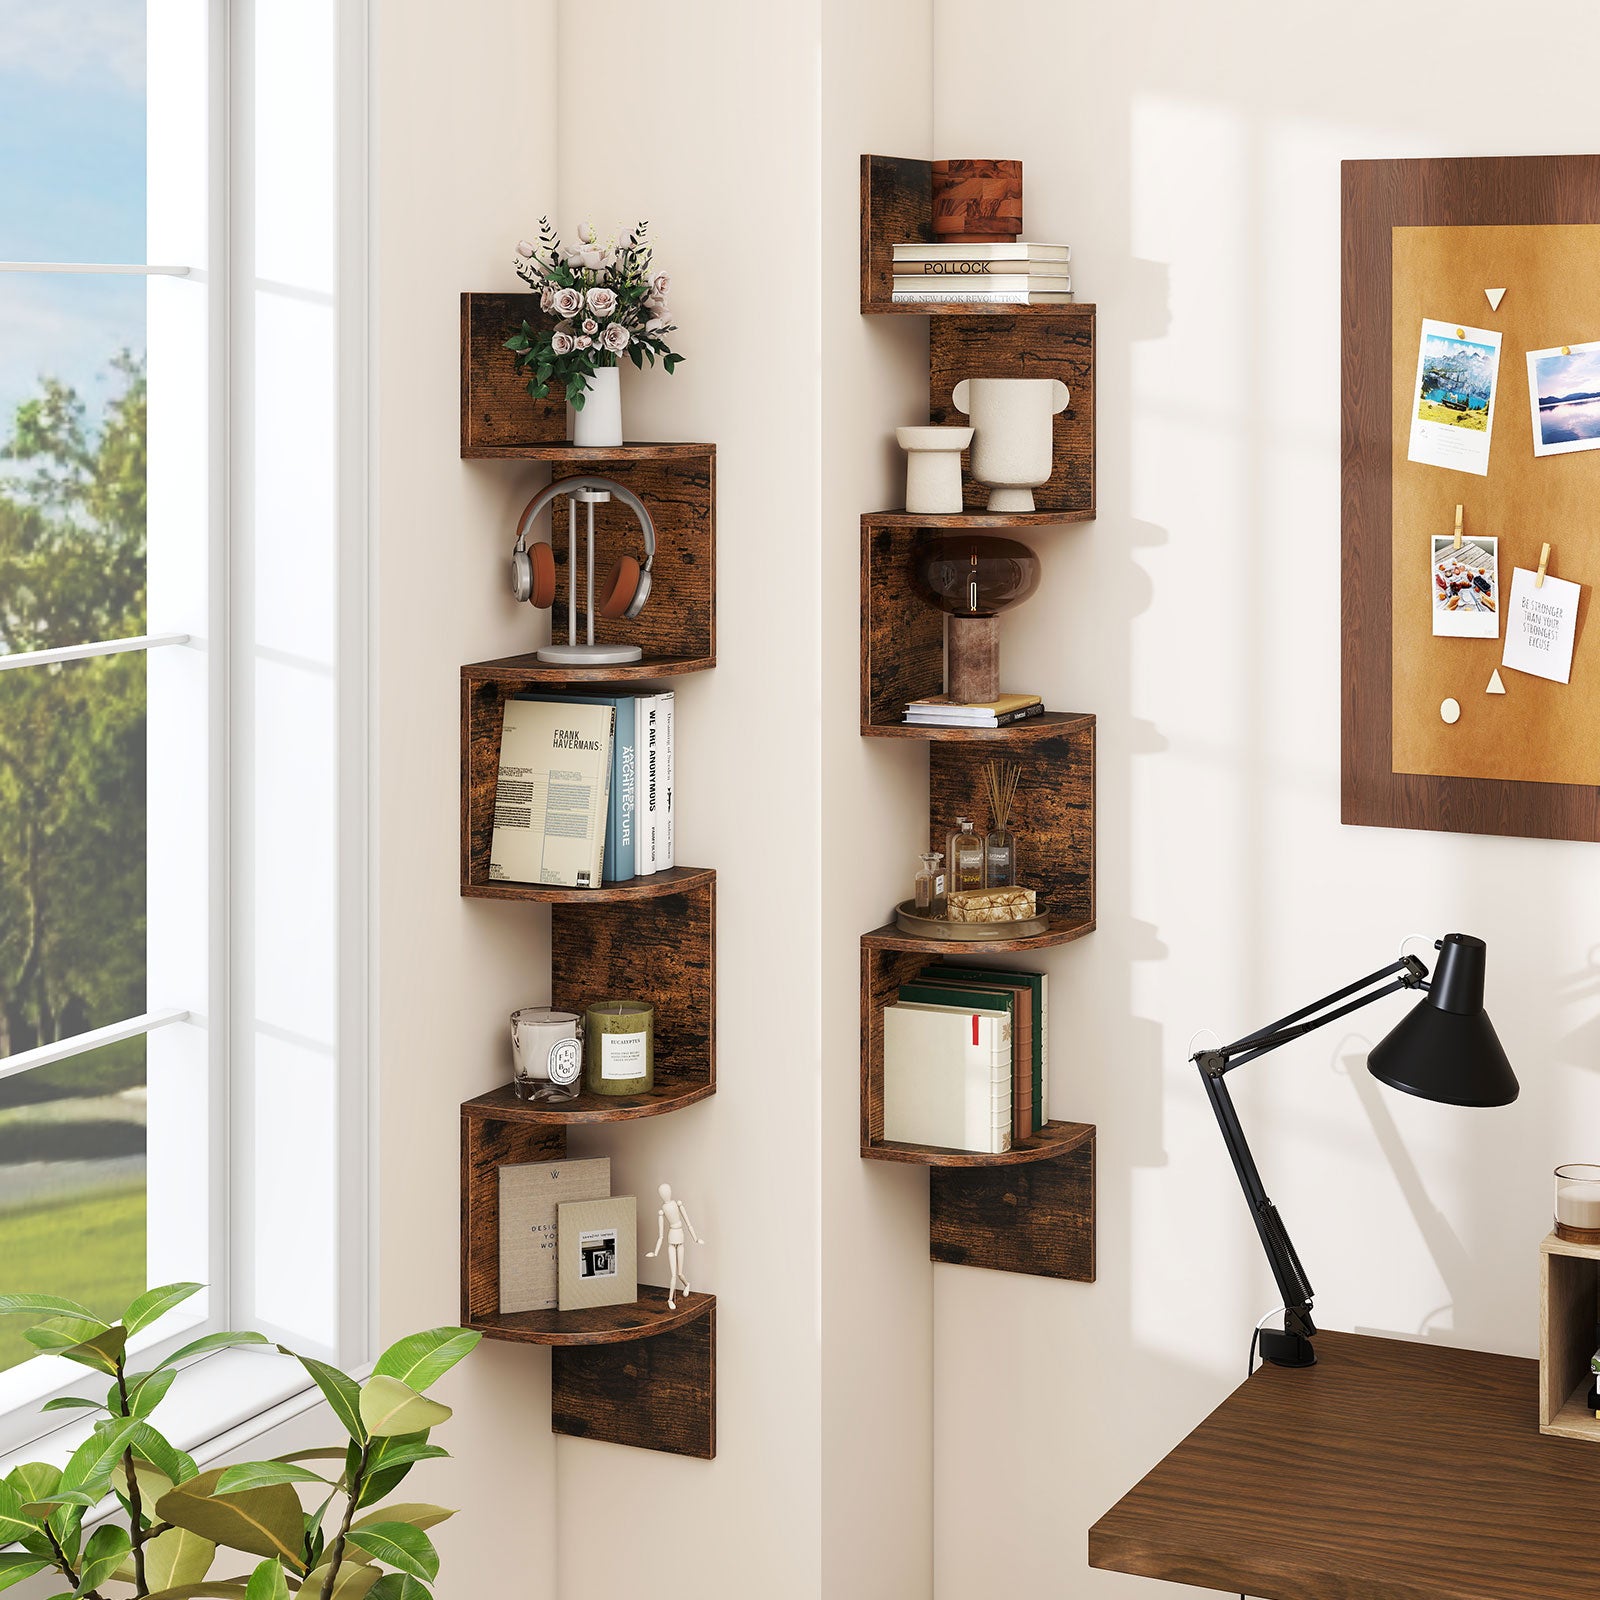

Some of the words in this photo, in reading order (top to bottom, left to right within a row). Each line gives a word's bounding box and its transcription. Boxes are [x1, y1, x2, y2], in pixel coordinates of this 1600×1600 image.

[924, 262, 990, 274] POLLOCK
[919, 295, 939, 304] NEW
[940, 295, 965, 304] LOOK
[966, 295, 1022, 304] REVOLUTION
[1521, 596, 1530, 610] BE
[1531, 600, 1563, 618] STRONGER
[1523, 611, 1541, 625] THAN
[1542, 616, 1560, 630] YOUR
[1523, 623, 1559, 641] STRONGEST
[1529, 636, 1551, 652] EXCUSE
[649, 710, 657, 726] WE
[554, 729, 579, 741] FRANK
[649, 728, 657, 748] ARE
[649, 750, 657, 812] ANONYMOUS
[622, 746, 631, 847] ARCHITECTURE
[531, 1223, 557, 1232] DESIG
